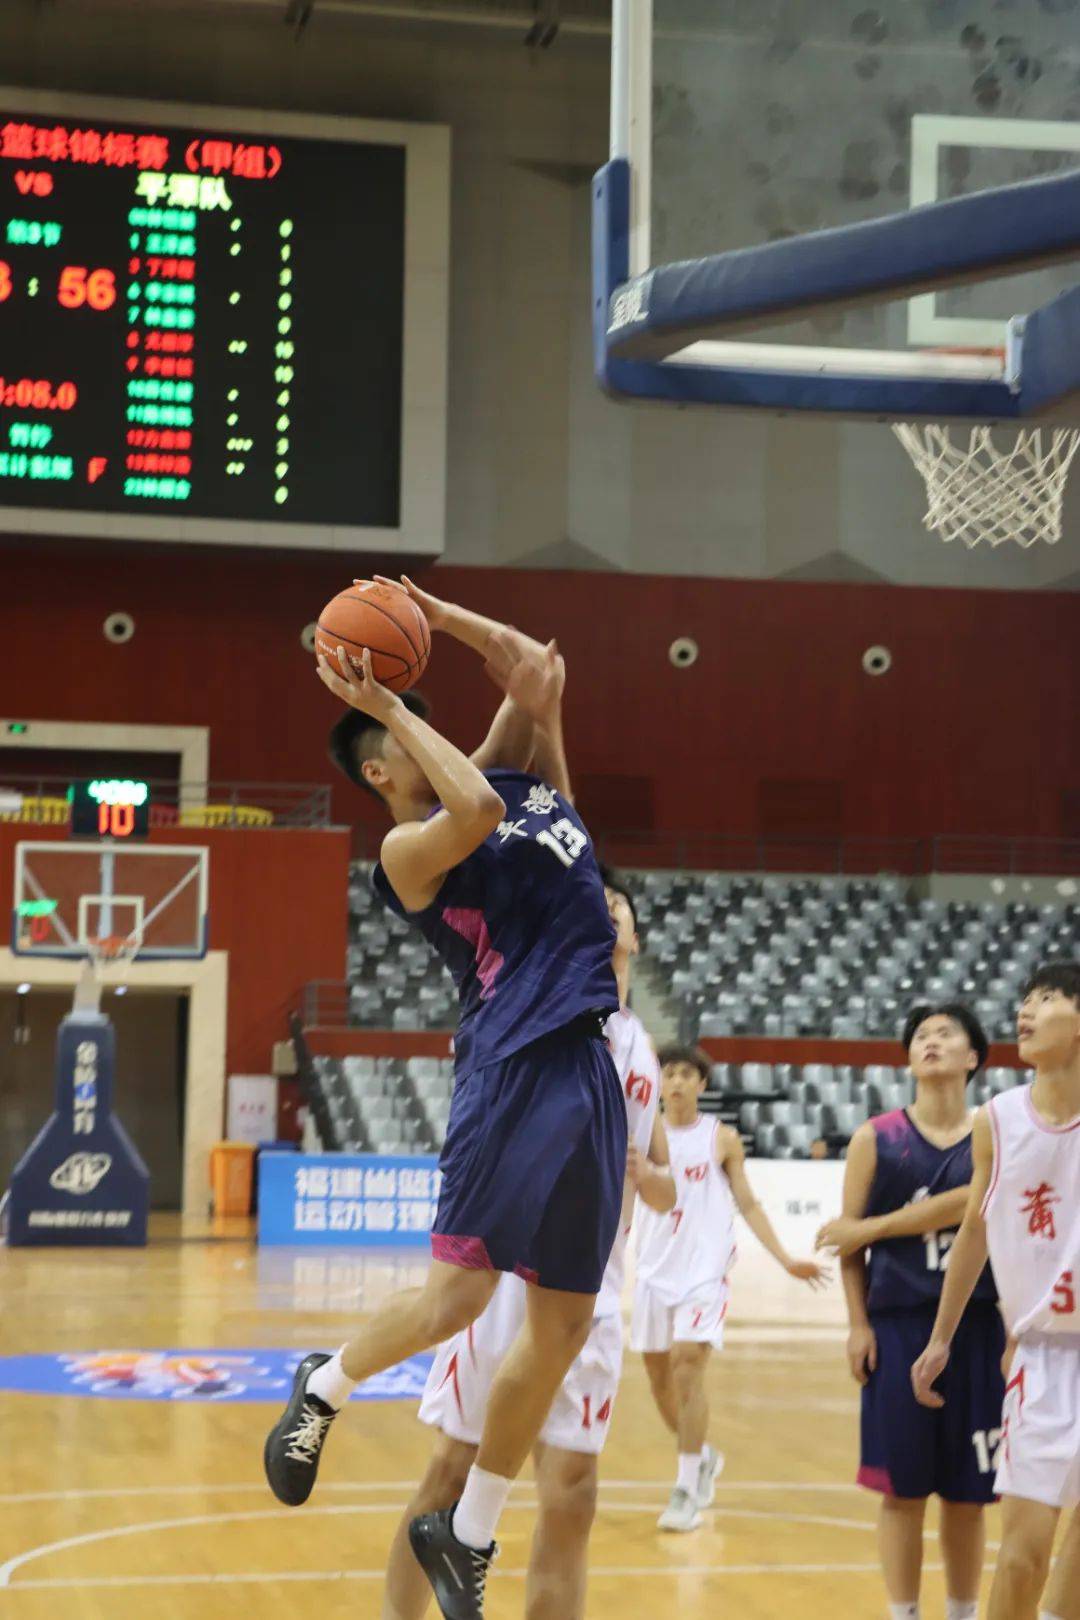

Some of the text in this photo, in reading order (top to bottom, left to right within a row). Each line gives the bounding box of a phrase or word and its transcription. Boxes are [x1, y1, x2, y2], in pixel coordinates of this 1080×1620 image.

[58, 266, 116, 311] 56
[98, 801, 134, 836] 10
[536, 817, 587, 868] 13
[1051, 1271, 1075, 1314] 5
